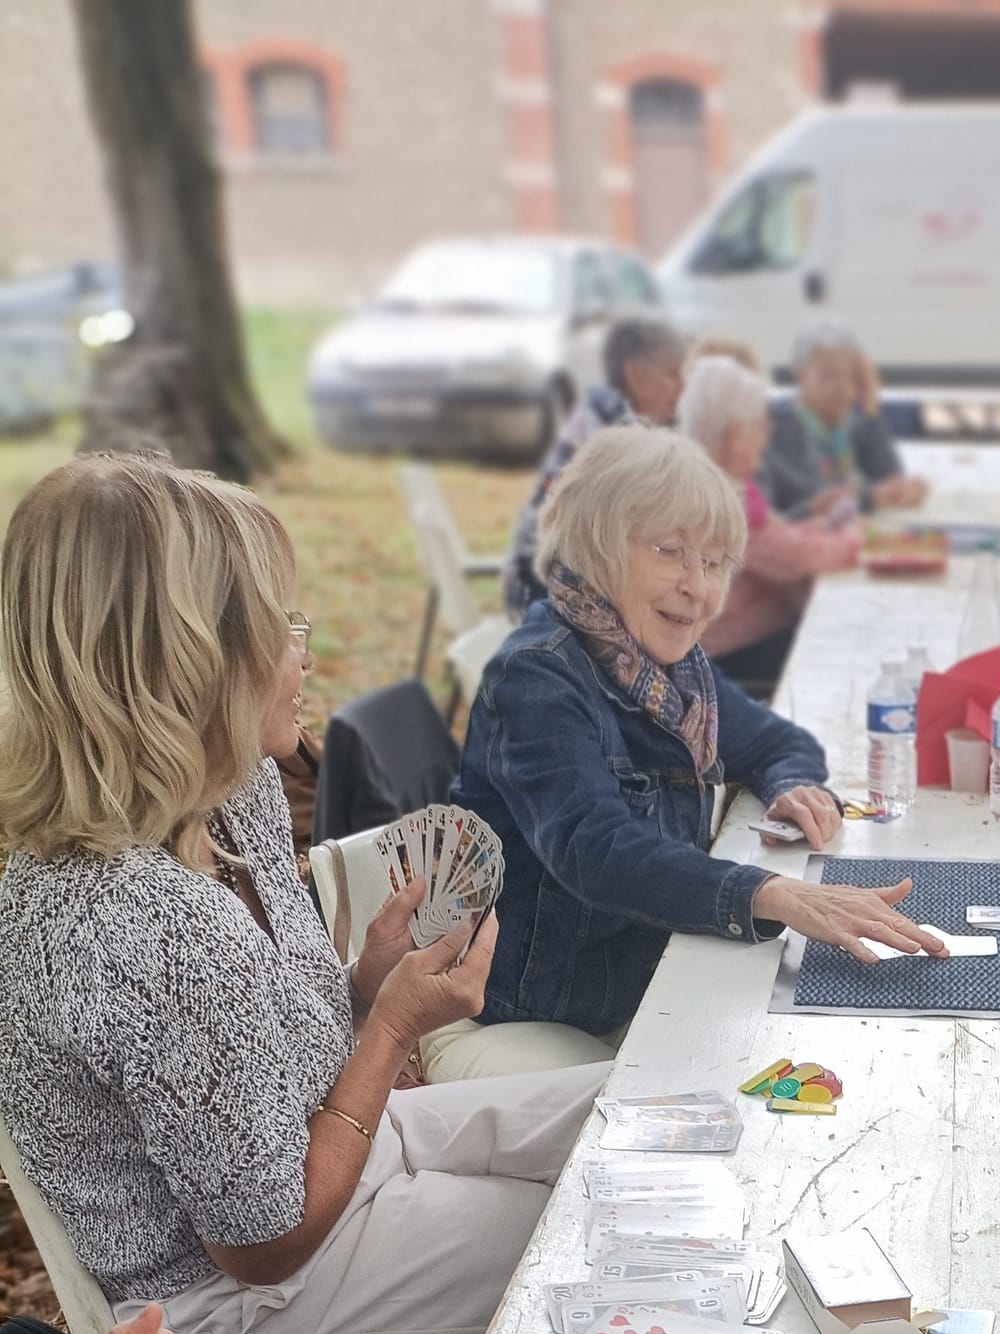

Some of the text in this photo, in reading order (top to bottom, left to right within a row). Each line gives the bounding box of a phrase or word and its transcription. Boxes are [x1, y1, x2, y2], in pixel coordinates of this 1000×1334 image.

[439, 812, 446, 828] 4
[466, 817, 479, 836] 16
[478, 831, 489, 847] 18
[779, 1082, 793, 1093] 10
[602, 1264, 622, 1278] 15
[552, 1286, 574, 1300] 20
[699, 1299, 718, 1308] 9
[571, 1310, 591, 1319] 9
